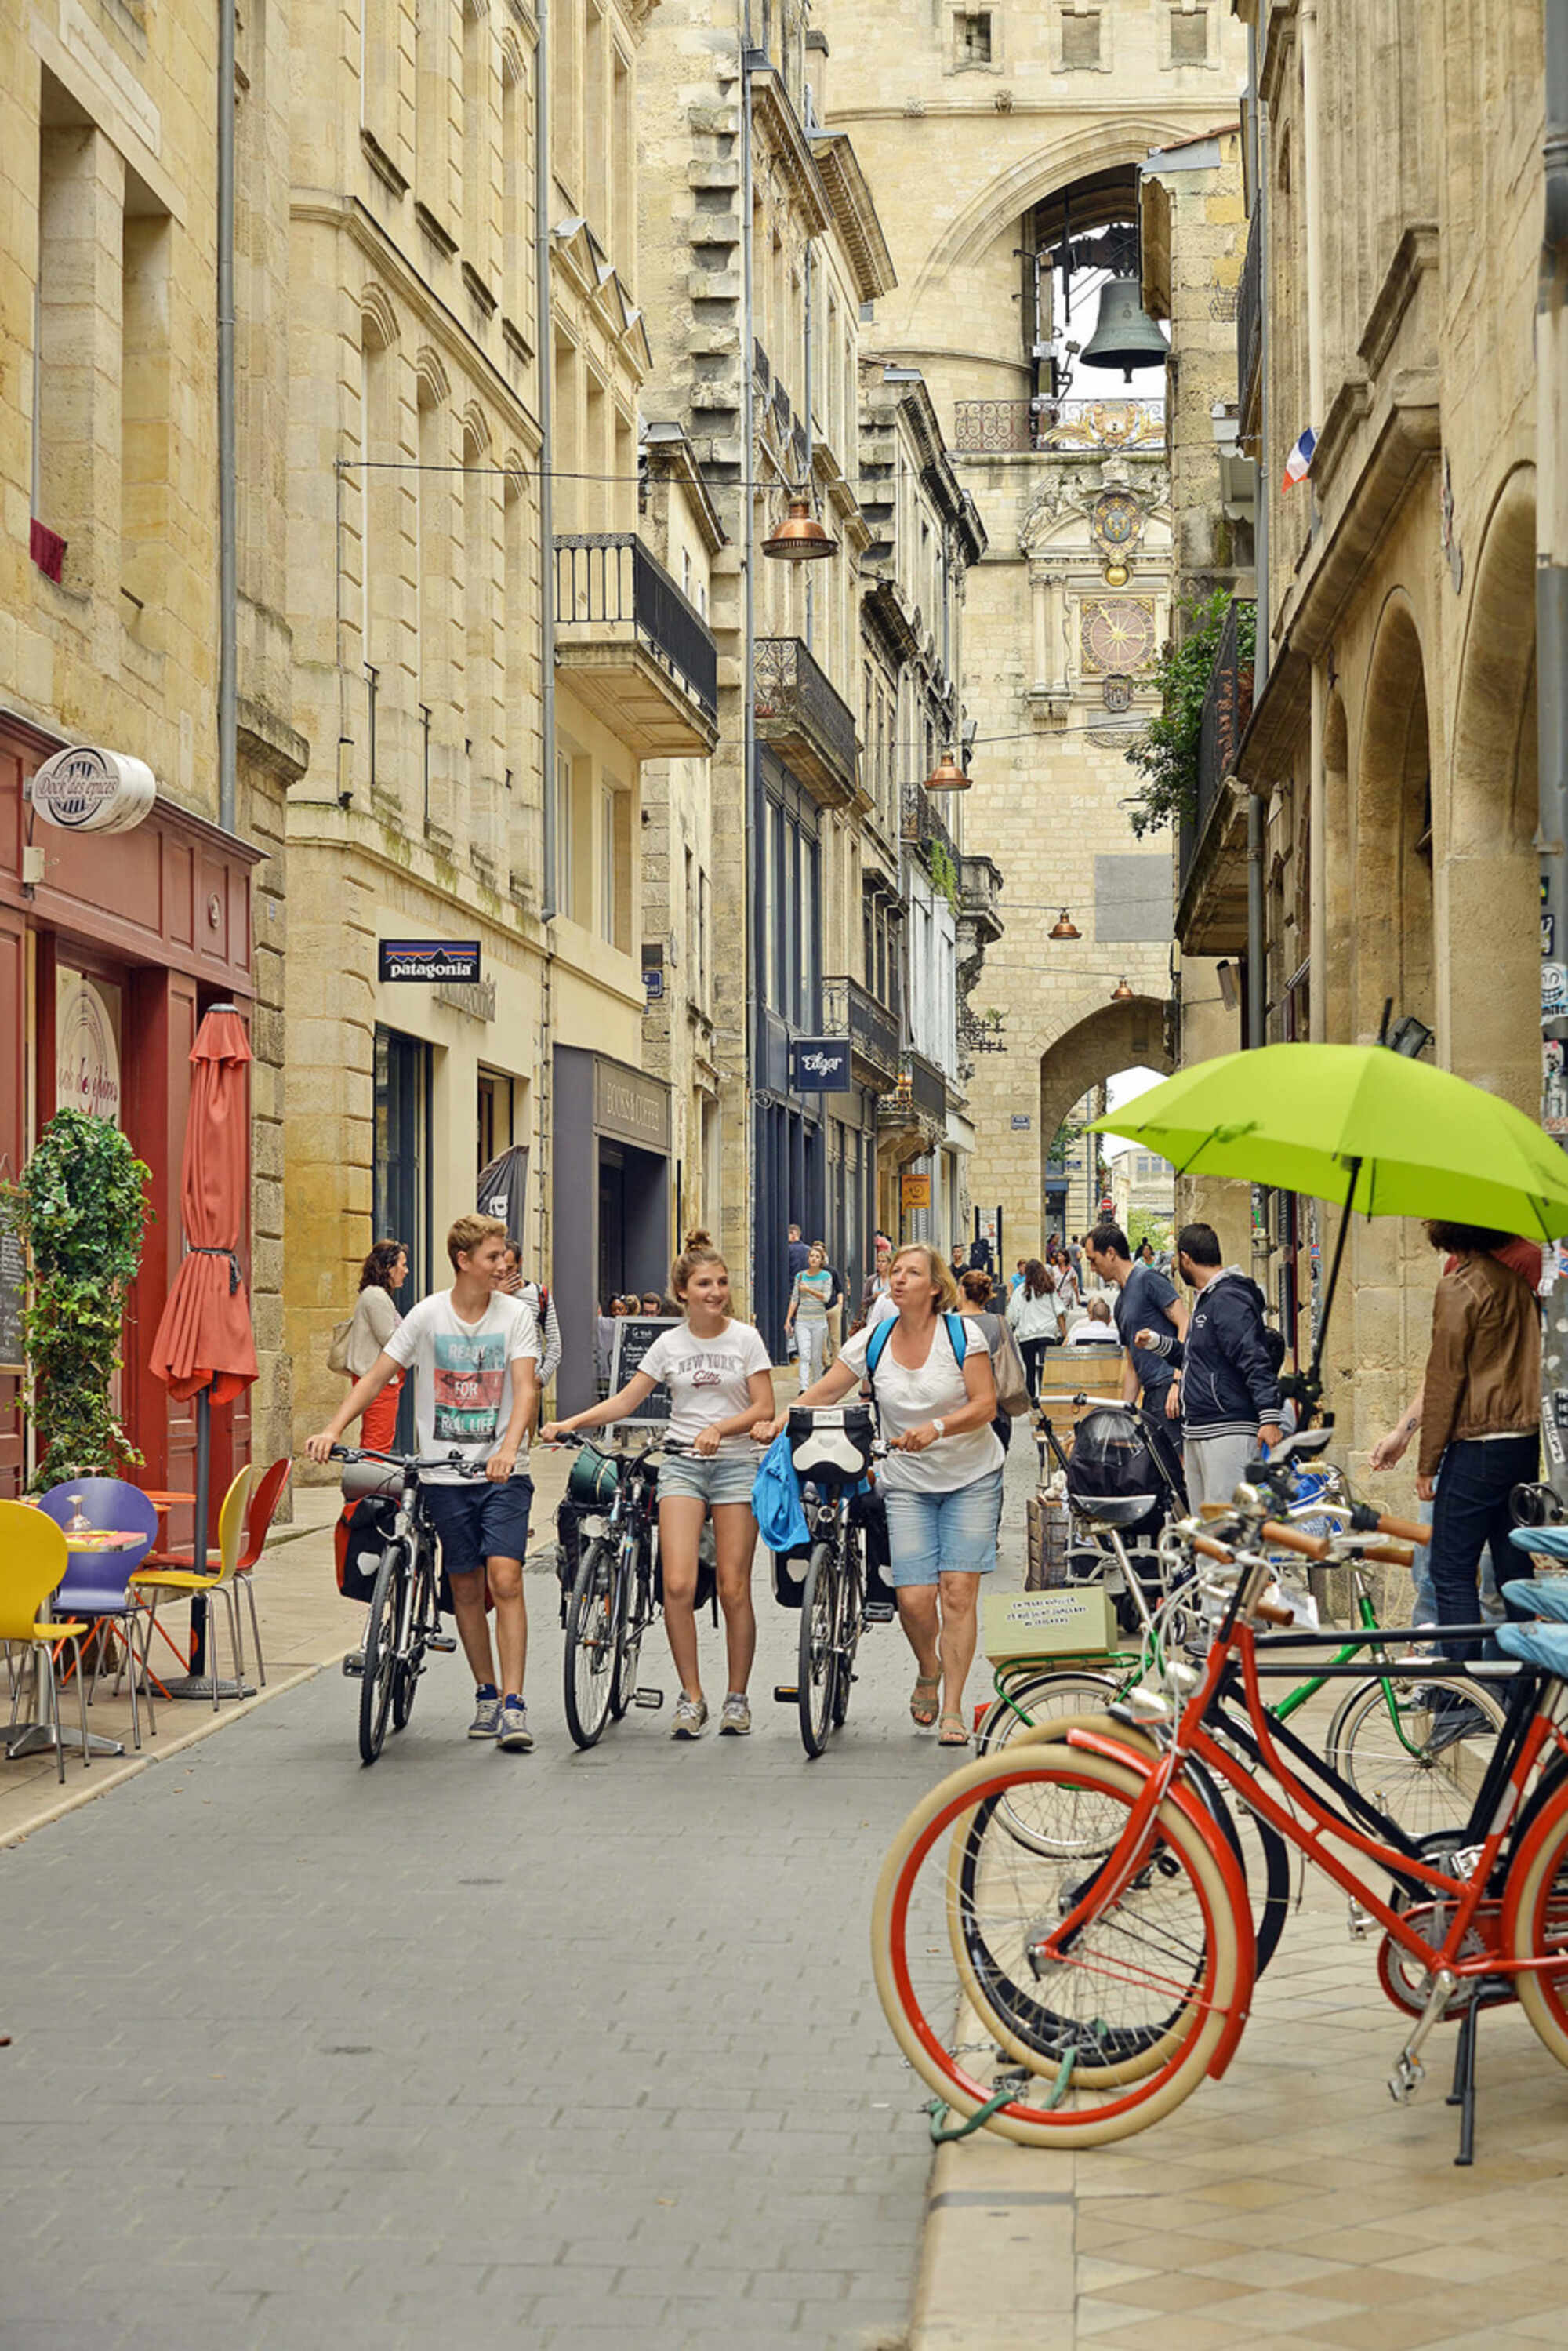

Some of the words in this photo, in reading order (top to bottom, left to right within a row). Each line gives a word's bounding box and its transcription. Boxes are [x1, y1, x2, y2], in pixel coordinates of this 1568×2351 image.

[390, 963, 471, 979] patagonia
[801, 1052, 843, 1077] Edgar
[678, 1354, 704, 1375] NEW
[706, 1354, 736, 1373] YORK
[691, 1369, 722, 1387] City
[455, 1380, 478, 1398] FOR
[470, 1416, 495, 1434] LIFE
